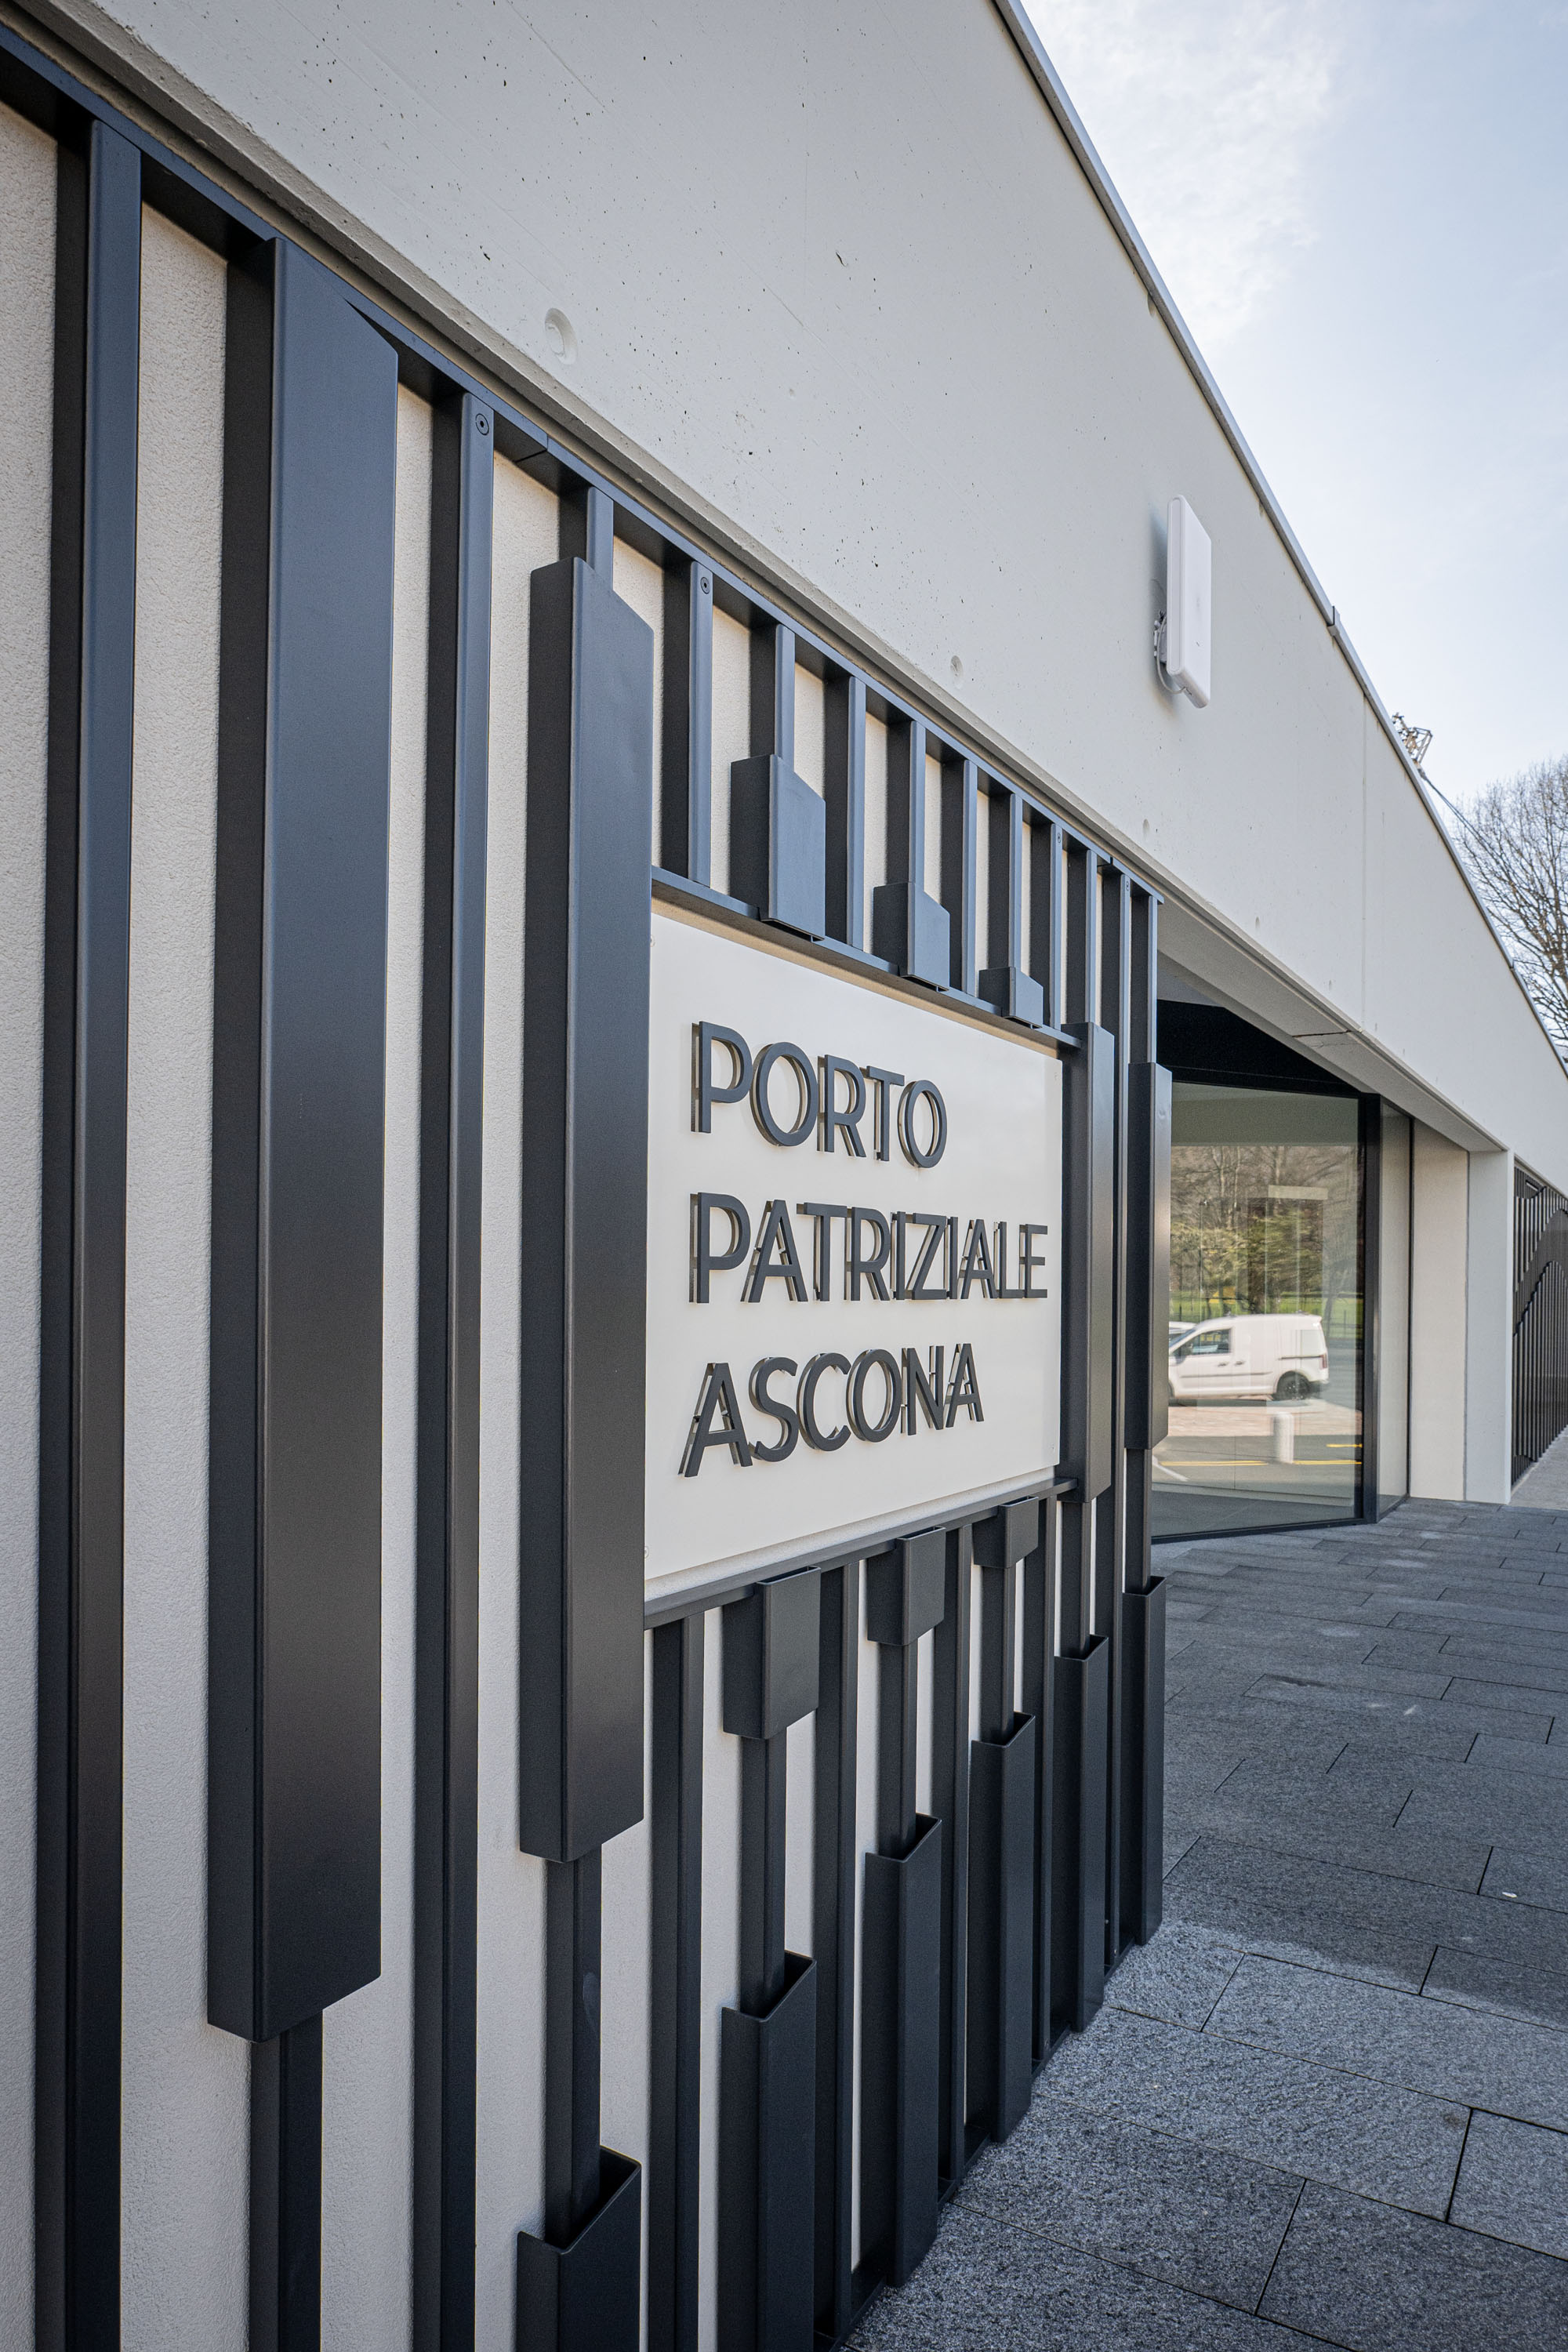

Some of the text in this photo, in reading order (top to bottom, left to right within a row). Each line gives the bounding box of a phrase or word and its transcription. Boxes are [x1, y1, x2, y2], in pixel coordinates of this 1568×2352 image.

[691, 1022, 947, 1168] PORTO
[689, 1192, 1047, 1303] PATRIZIALE
[678, 1343, 984, 1477] ASCONA
